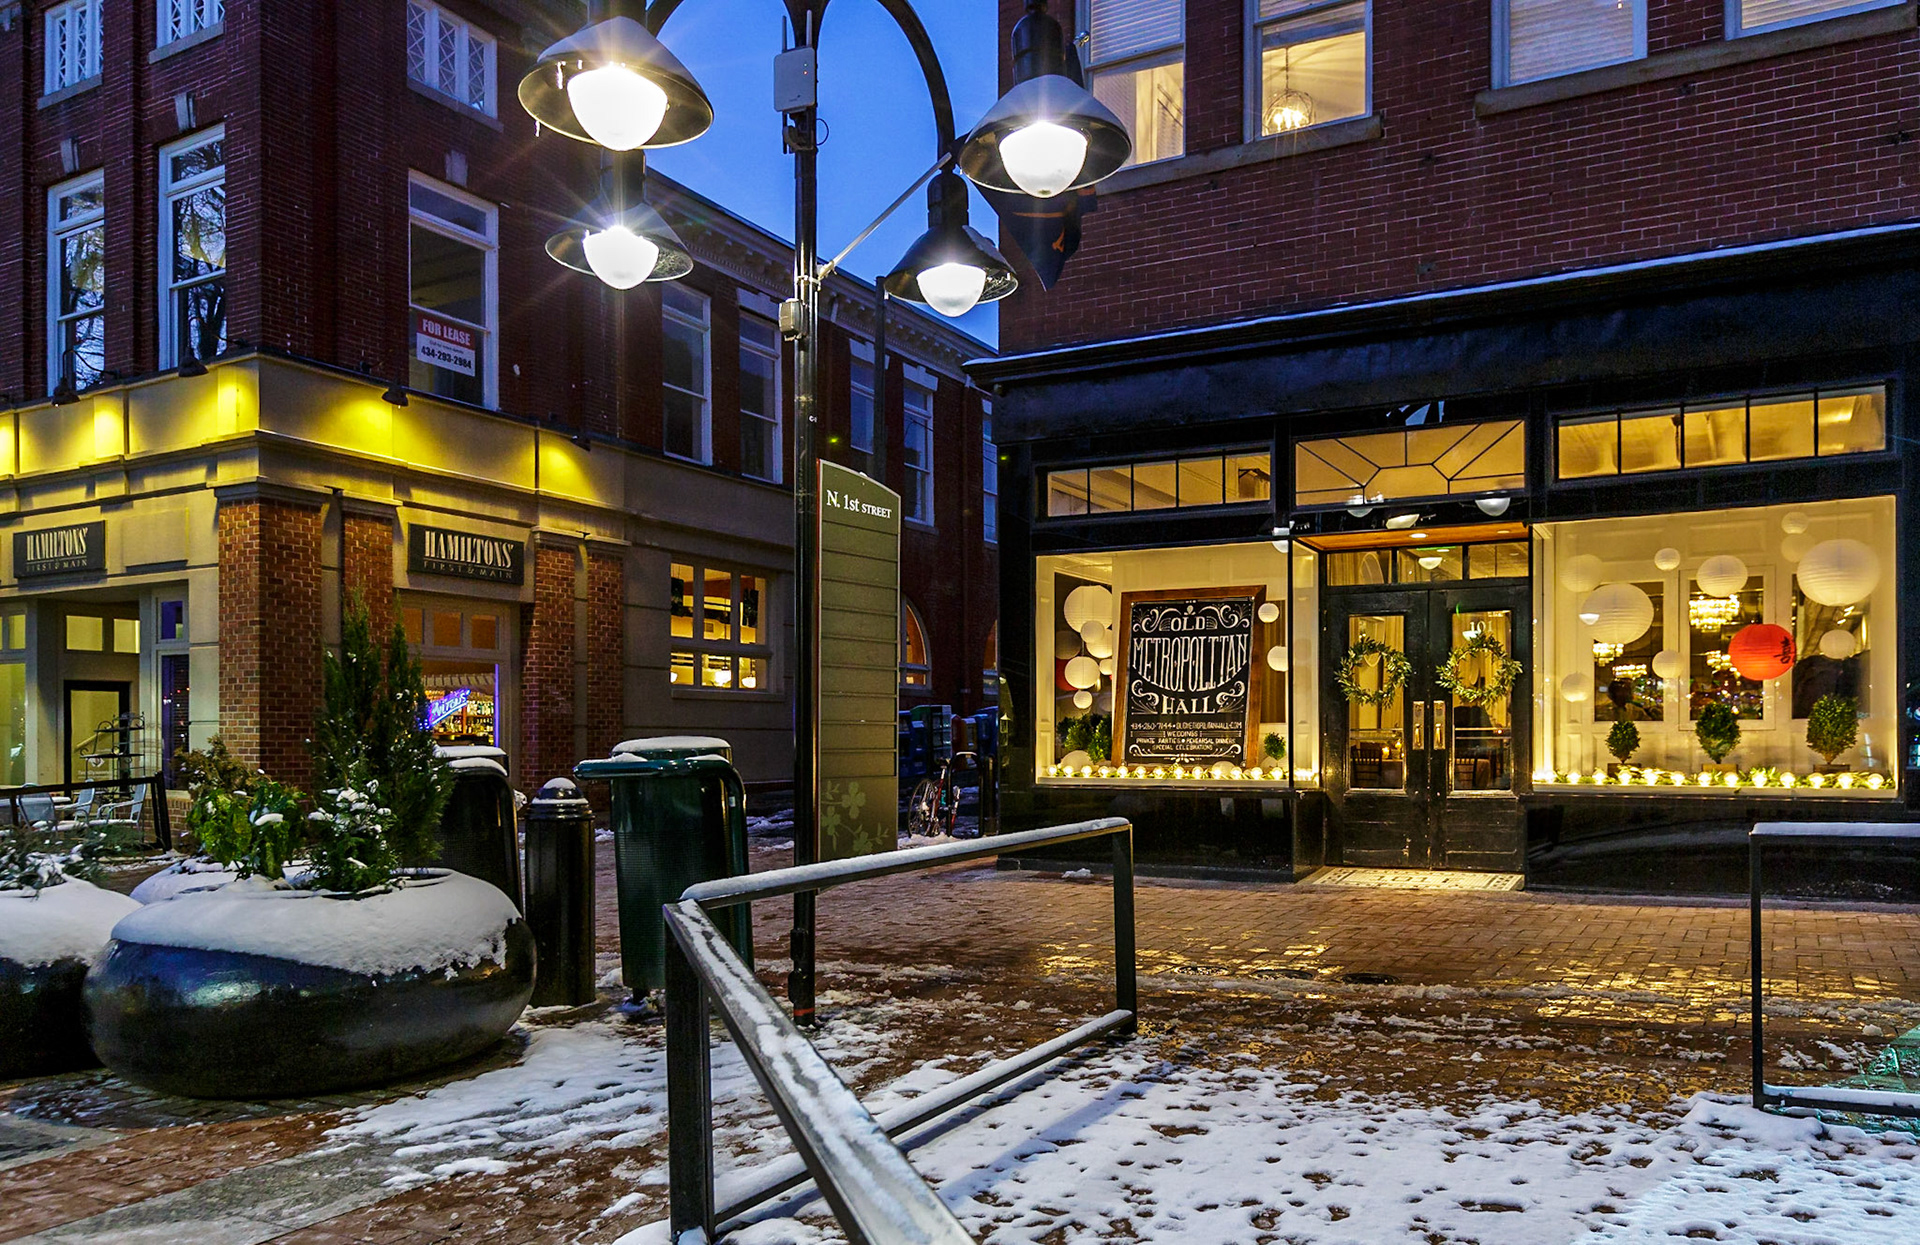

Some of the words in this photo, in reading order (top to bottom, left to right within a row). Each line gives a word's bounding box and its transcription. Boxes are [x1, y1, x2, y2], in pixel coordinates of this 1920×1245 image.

[422, 318, 442, 336] FOR
[443, 326, 471, 346] LEASE
[826, 489, 841, 508] N.
[843, 494, 860, 512] 1st
[861, 503, 892, 518] STREET
[27, 562, 52, 572] FIRST
[63, 559, 88, 568] MAIN
[423, 561, 462, 573] FIRST
[466, 566, 475, 574] &
[479, 568, 514, 580] MAIN
[1170, 616, 1206, 631] OLD
[1470, 620, 1493, 634] 101
[1132, 634, 1249, 692] METROPOLITAN
[1161, 694, 1216, 714] HALL
